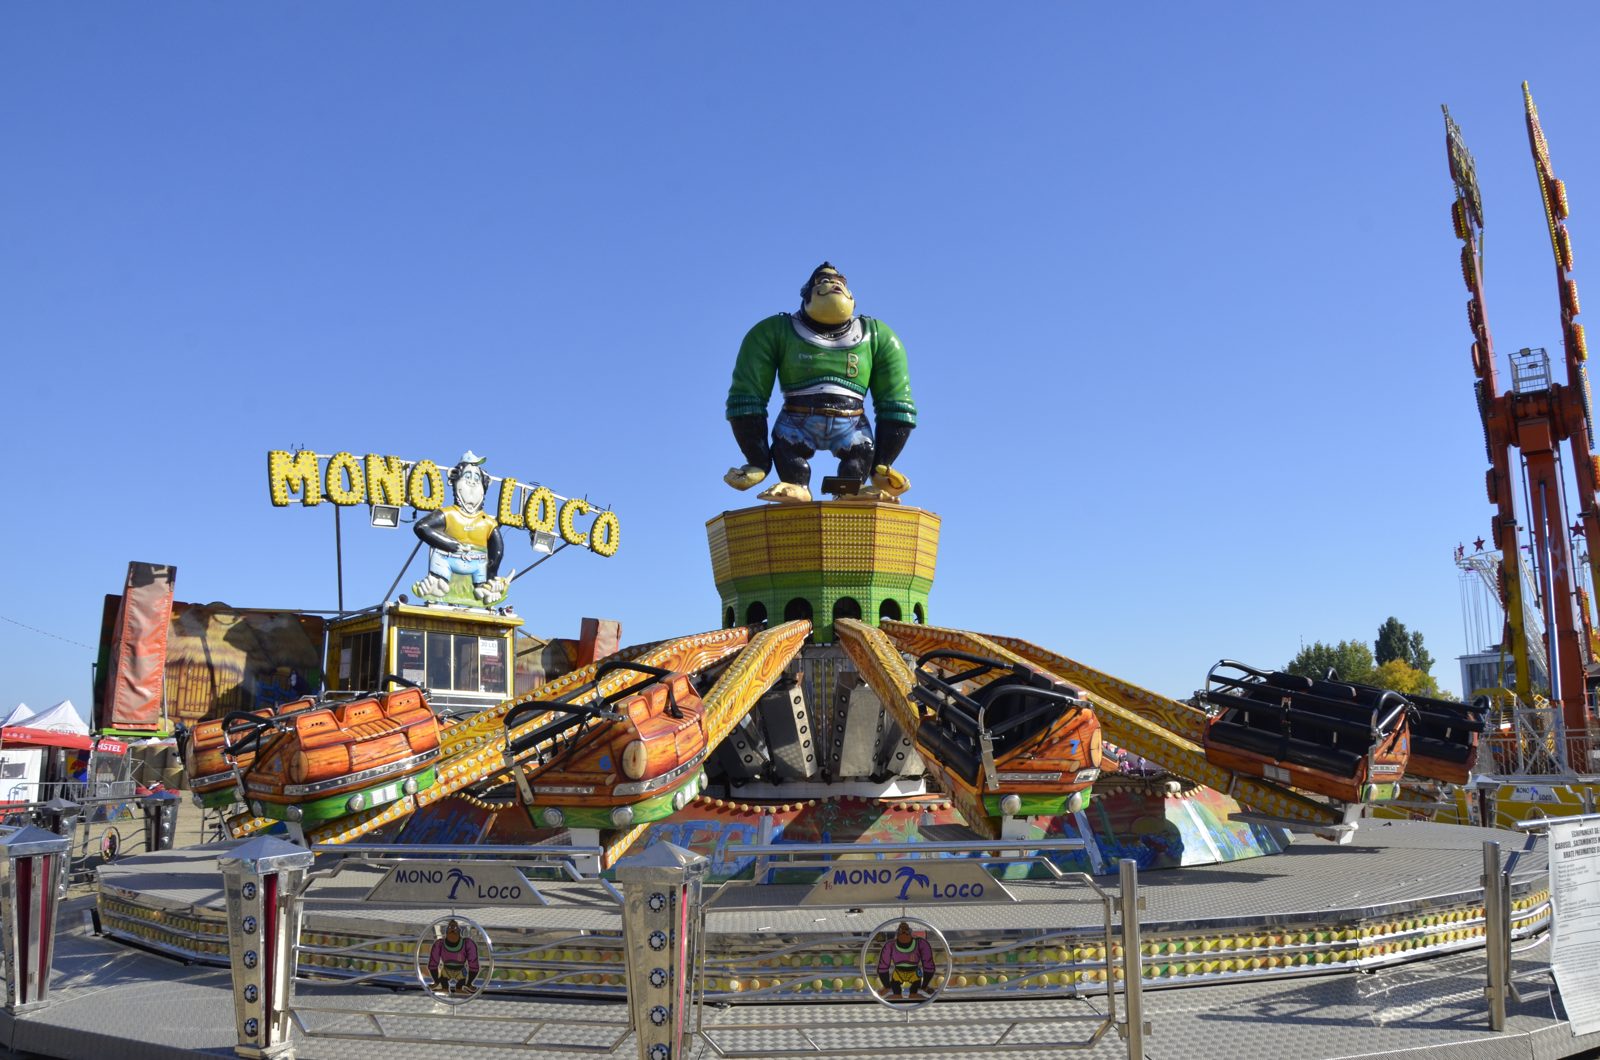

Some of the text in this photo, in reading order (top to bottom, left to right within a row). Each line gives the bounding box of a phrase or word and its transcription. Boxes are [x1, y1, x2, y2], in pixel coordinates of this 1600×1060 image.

[846, 352, 859, 378] B
[268, 450, 620, 558] MONO LOCO
[1070, 740, 1081, 755] 7
[395, 870, 521, 899] MONO LOCO
[833, 869, 984, 898] MONO LOCO
